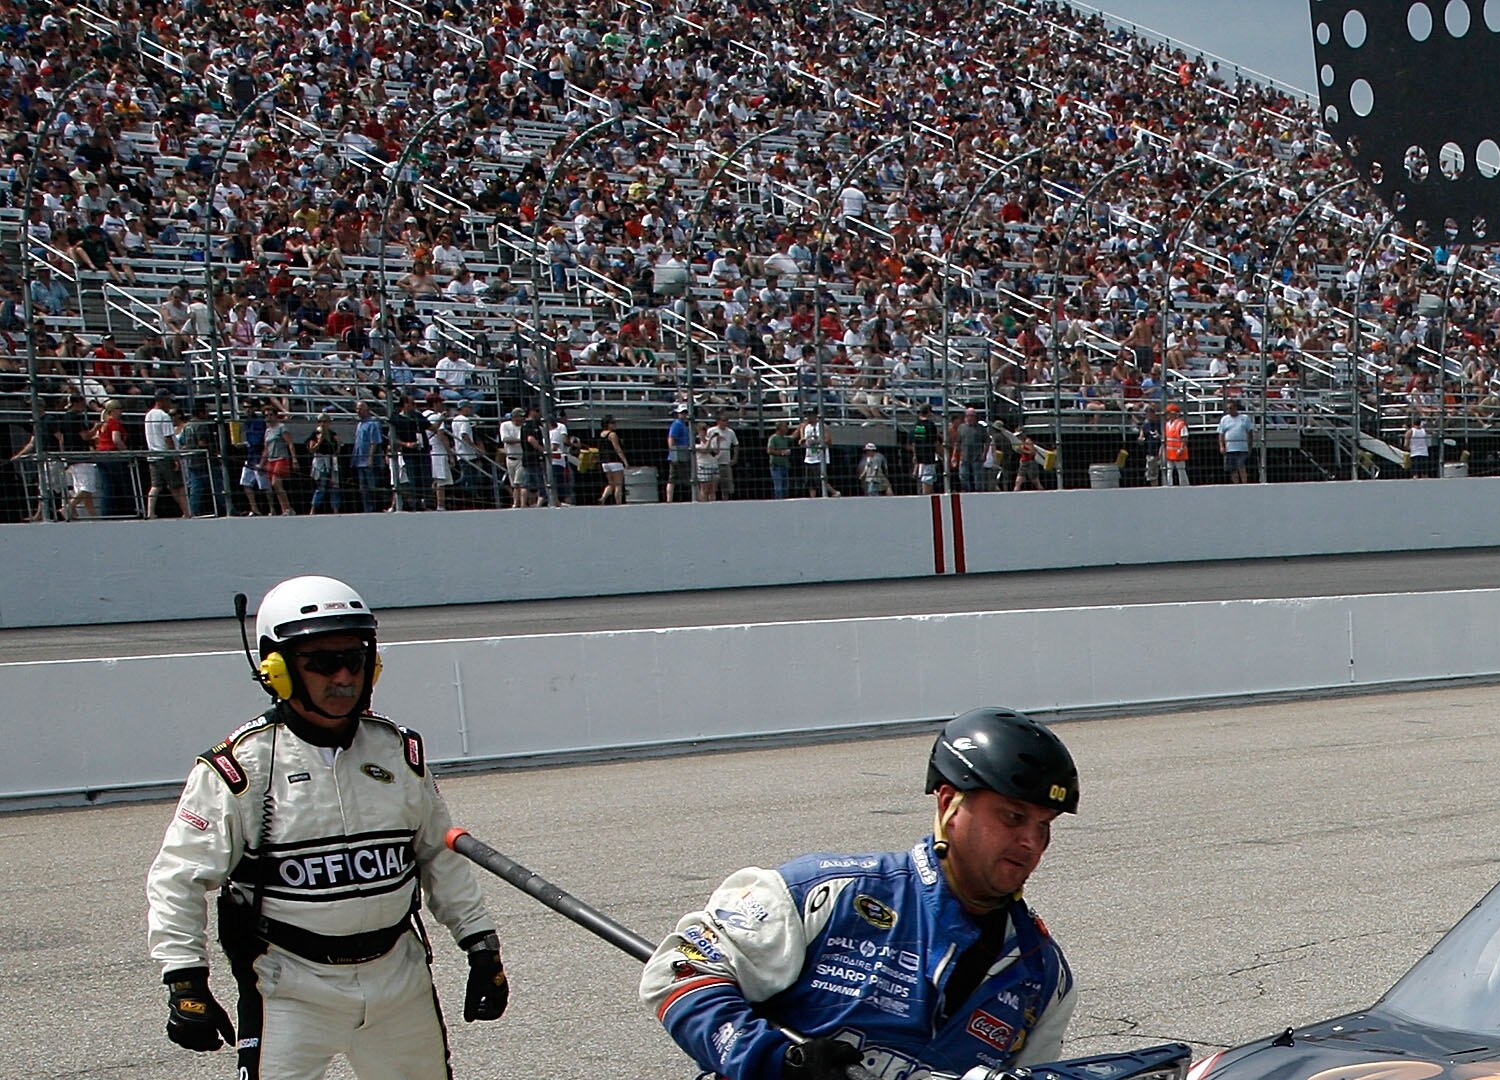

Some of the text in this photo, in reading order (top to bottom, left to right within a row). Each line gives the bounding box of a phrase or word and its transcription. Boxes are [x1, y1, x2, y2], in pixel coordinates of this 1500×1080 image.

[1049, 784, 1067, 802] 00
[279, 846, 408, 887] OFFICIAL
[811, 979, 861, 997] SYLVANIA
[816, 964, 910, 998] SHARP PHILIPS
